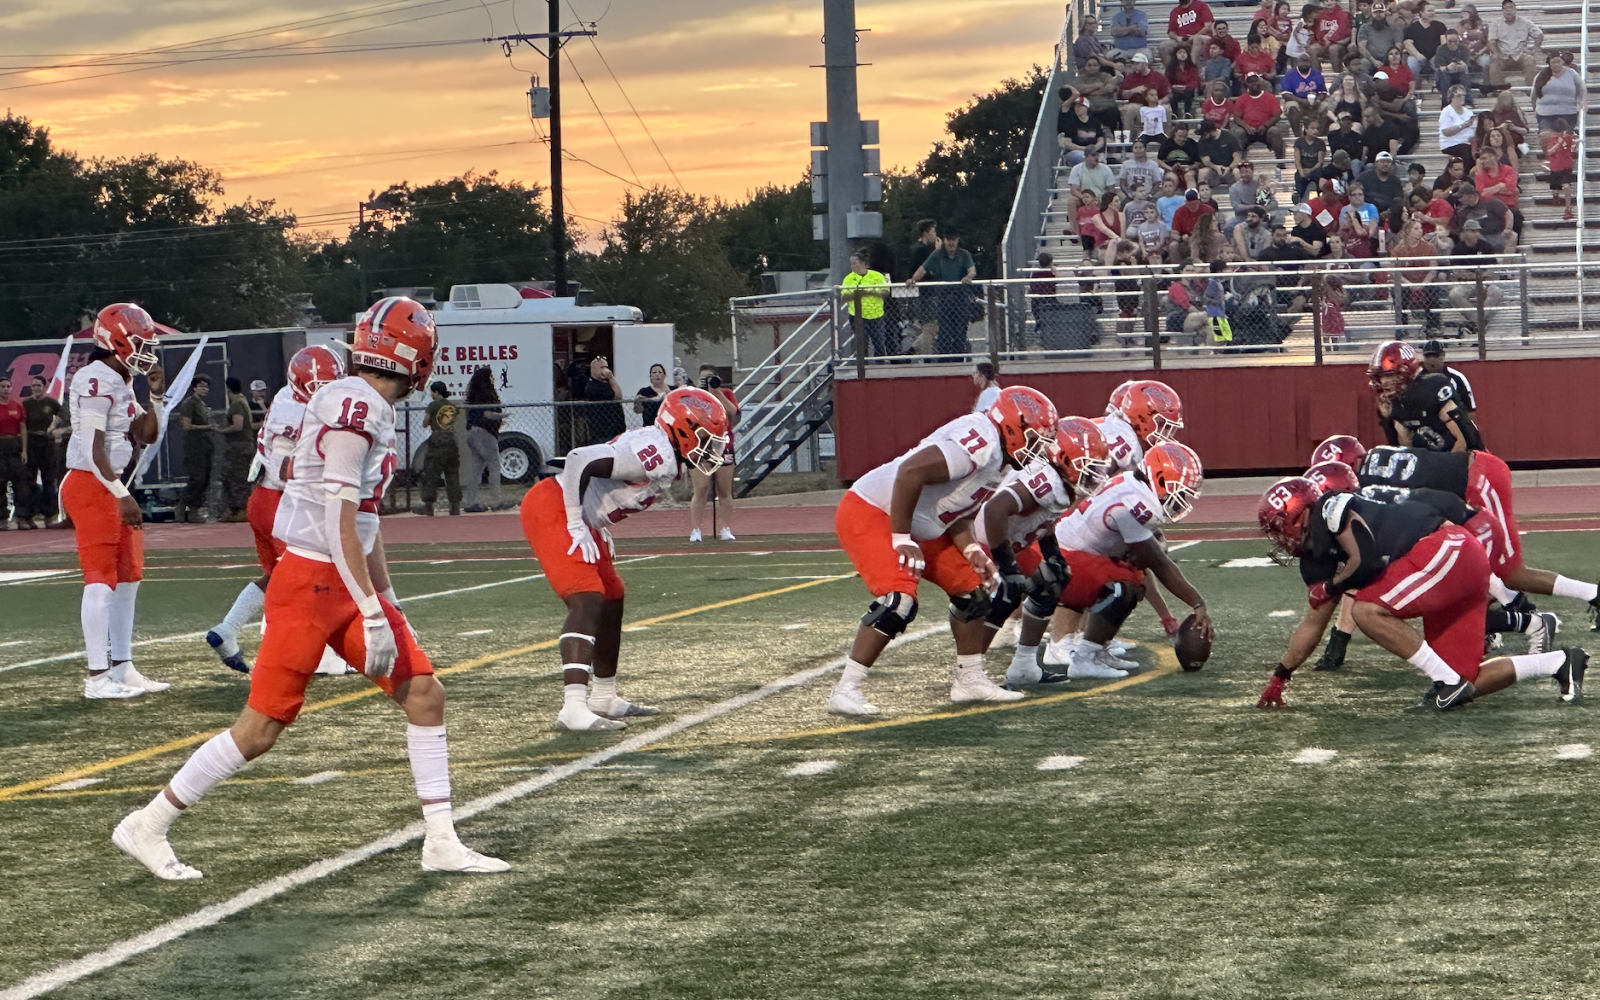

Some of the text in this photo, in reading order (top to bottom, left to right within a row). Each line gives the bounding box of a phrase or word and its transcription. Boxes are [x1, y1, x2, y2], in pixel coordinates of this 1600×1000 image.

[363, 355, 397, 371] ANGELO
[456, 345, 518, 361] BELLES
[434, 365, 454, 375] ILL
[88, 377, 98, 396] 3
[337, 397, 369, 430] 12
[959, 428, 988, 454] 77
[1108, 434, 1132, 460] 75
[1321, 443, 1342, 461] 54
[636, 444, 664, 472] 25
[1028, 472, 1053, 499] 50
[1267, 486, 1292, 510] 63
[1130, 501, 1153, 525] 52
